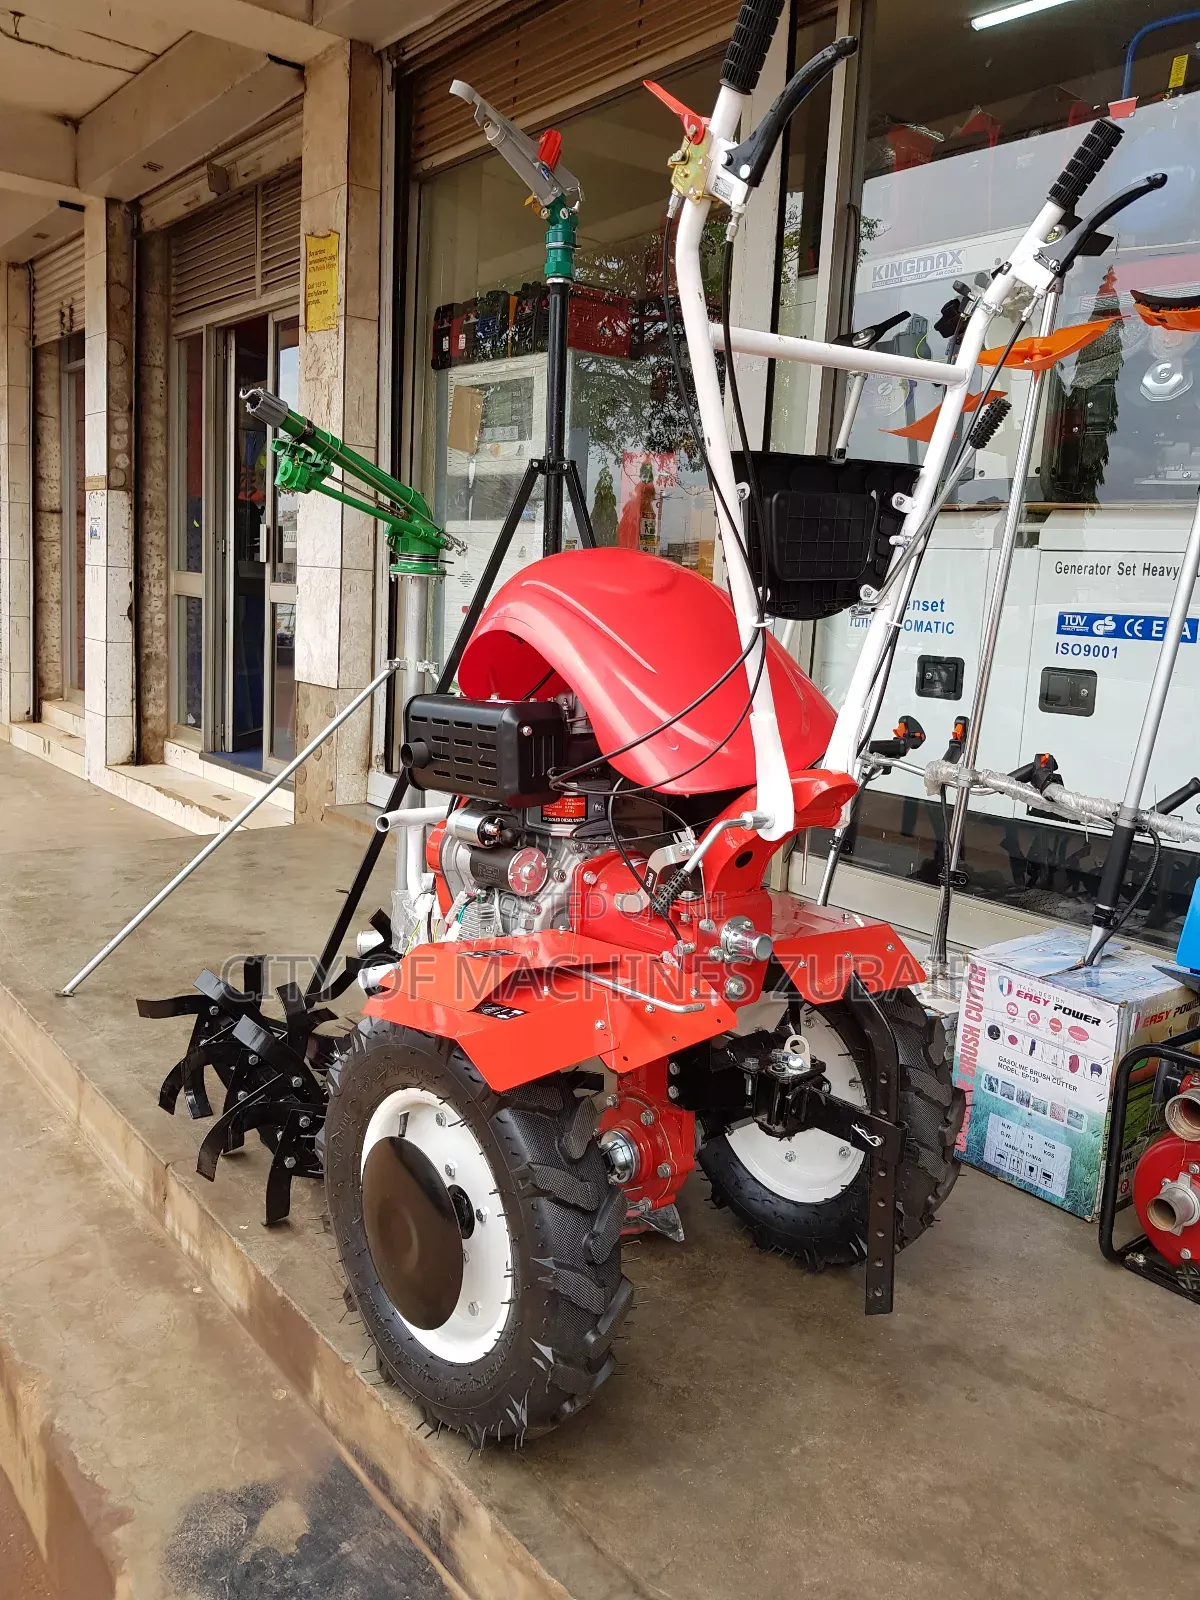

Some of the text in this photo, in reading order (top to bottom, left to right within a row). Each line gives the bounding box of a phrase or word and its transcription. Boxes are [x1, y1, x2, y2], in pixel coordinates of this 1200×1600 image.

[872, 249, 963, 281] KINGMAX
[1055, 561, 1111, 575] Generator
[1117, 562, 1137, 576] Set
[1142, 562, 1180, 580] Heavy
[906, 597, 945, 613] enset
[903, 618, 955, 634] OMATIC
[1063, 615, 1088, 626] TÜV
[1151, 619, 1192, 640] EA
[1055, 641, 1118, 659] ISO9001
[964, 963, 987, 1023] CUTTER
[1015, 989, 1102, 1027] EASY POWER
[1142, 1008, 1173, 1029] EASY
[957, 1023, 981, 1079] BRUSH
[998, 1055, 1078, 1093] GASOLINE BRUSH CUTTER
